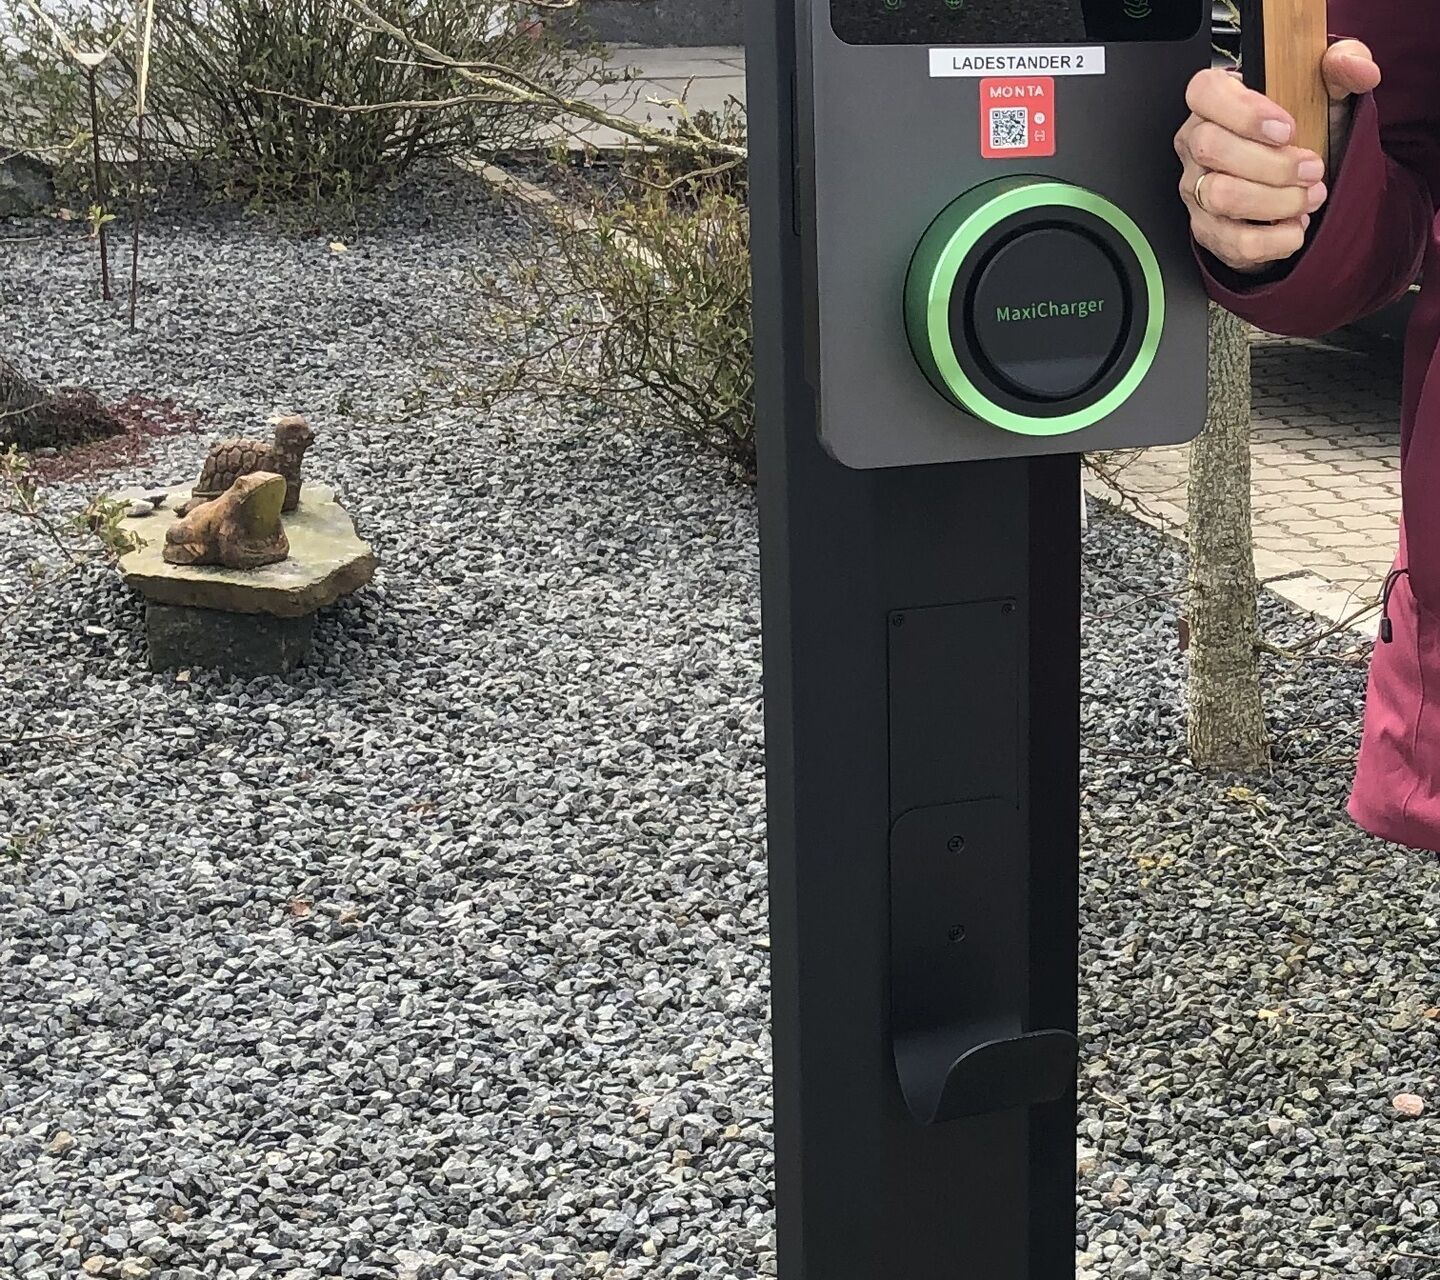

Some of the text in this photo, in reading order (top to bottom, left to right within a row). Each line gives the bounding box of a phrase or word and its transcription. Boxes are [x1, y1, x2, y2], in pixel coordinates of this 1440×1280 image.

[952, 55, 1084, 70] LADESTANDER 2
[989, 85, 1045, 98] MONTA
[996, 299, 1105, 322] MaxiCharger
